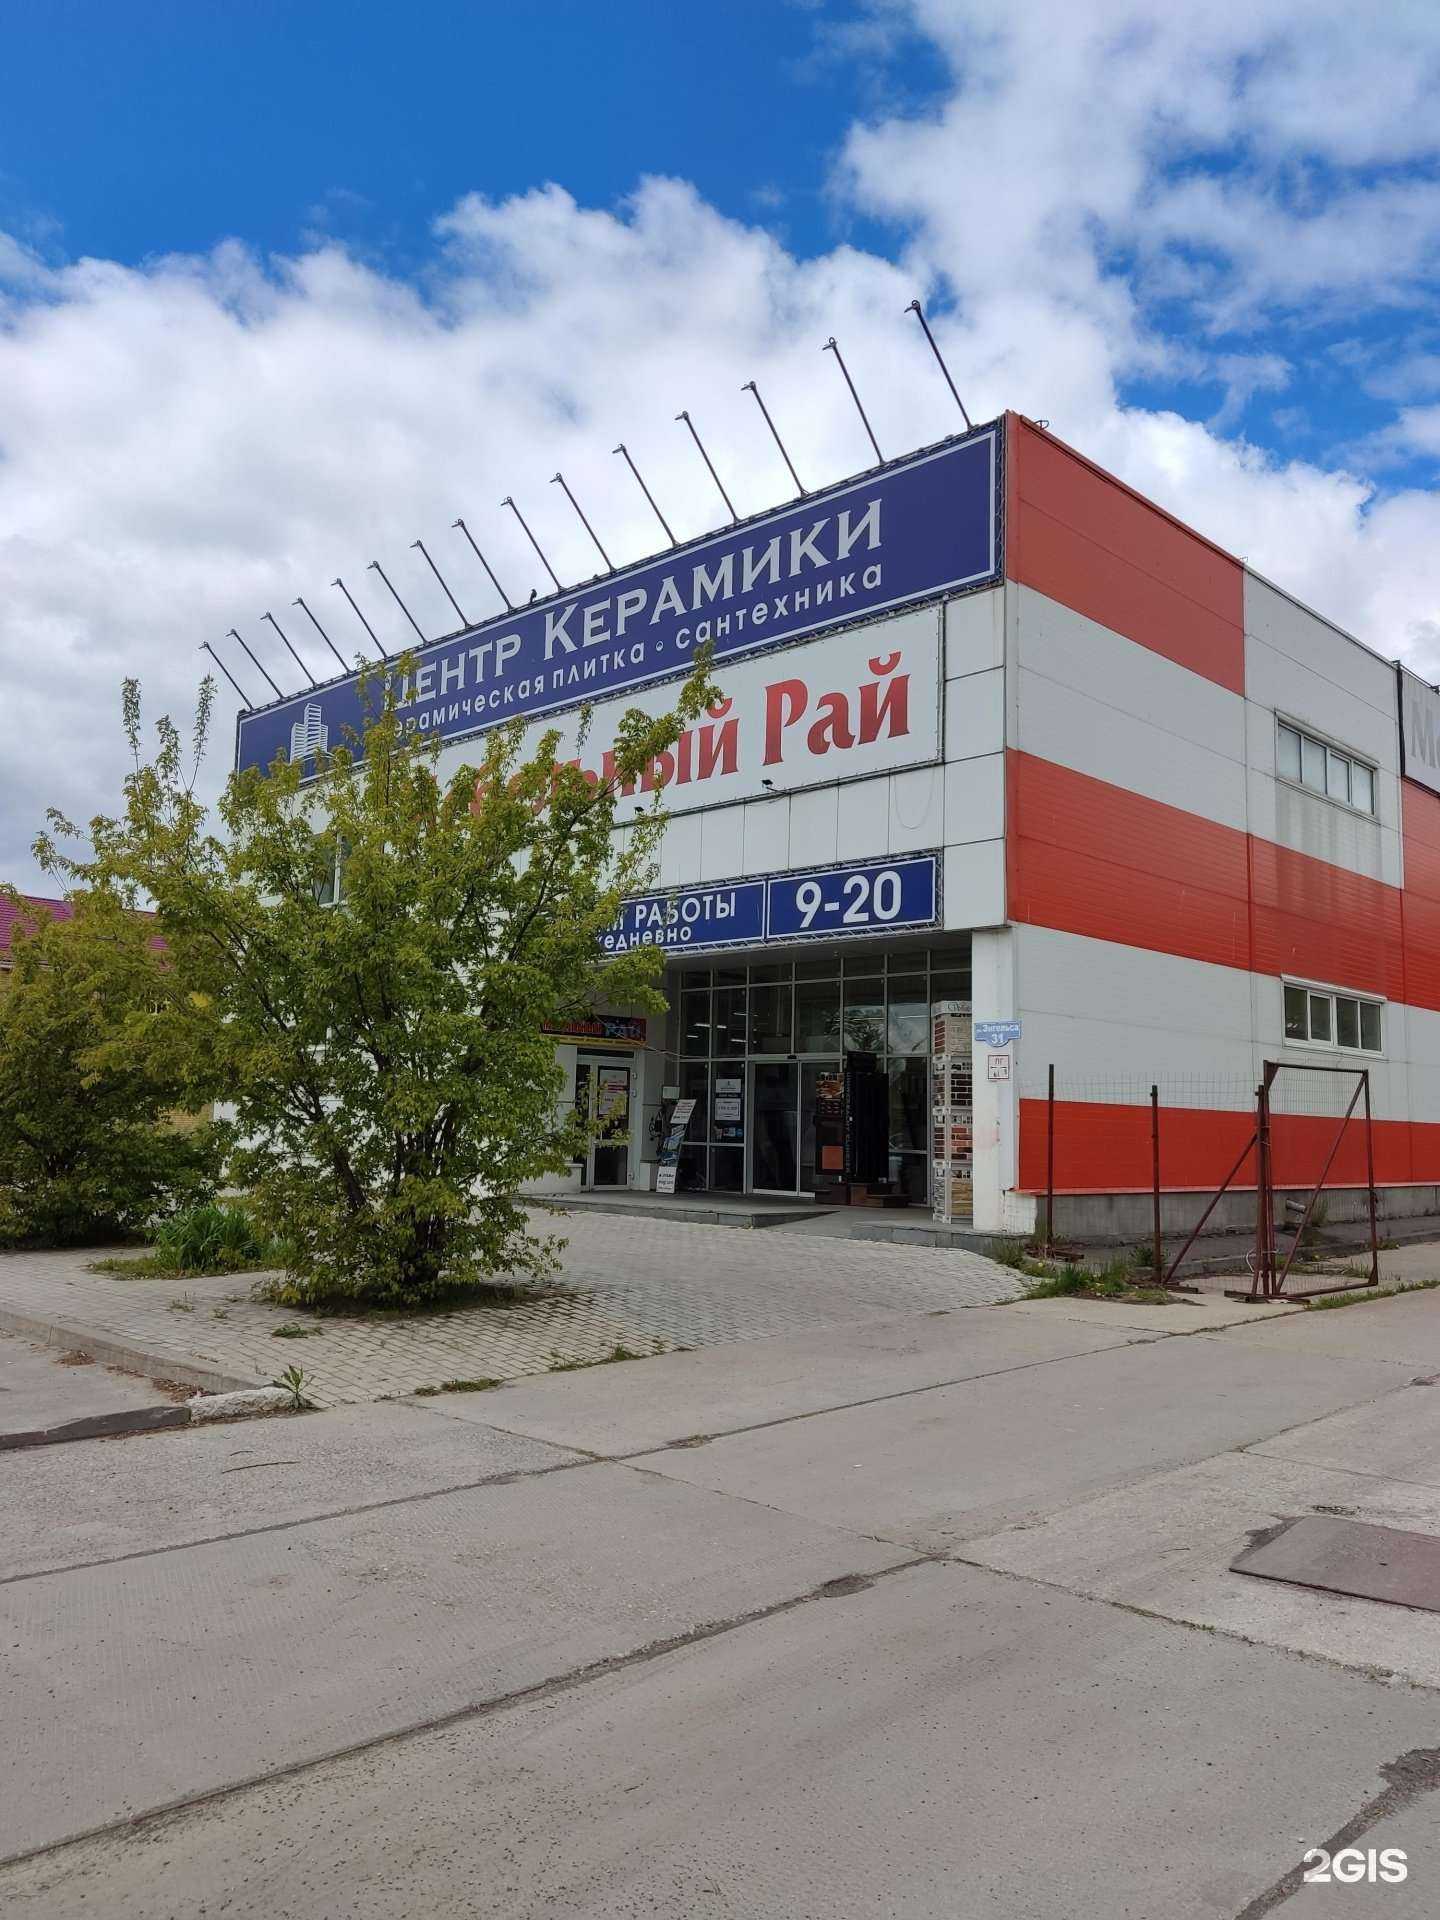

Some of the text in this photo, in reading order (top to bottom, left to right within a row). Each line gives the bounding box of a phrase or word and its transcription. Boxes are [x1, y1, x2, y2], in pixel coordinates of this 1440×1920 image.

[385, 498, 882, 711] ЦЕНТР КЕРАМИКИ
[388, 563, 882, 736] ерамическая плитка сантехника
[762, 650, 911, 766] Рай
[635, 892, 736, 929] РАБОТЫ
[795, 870, 902, 929] 9-20
[596, 926, 692, 951] едневно
[991, 1033, 1004, 1044] 31
